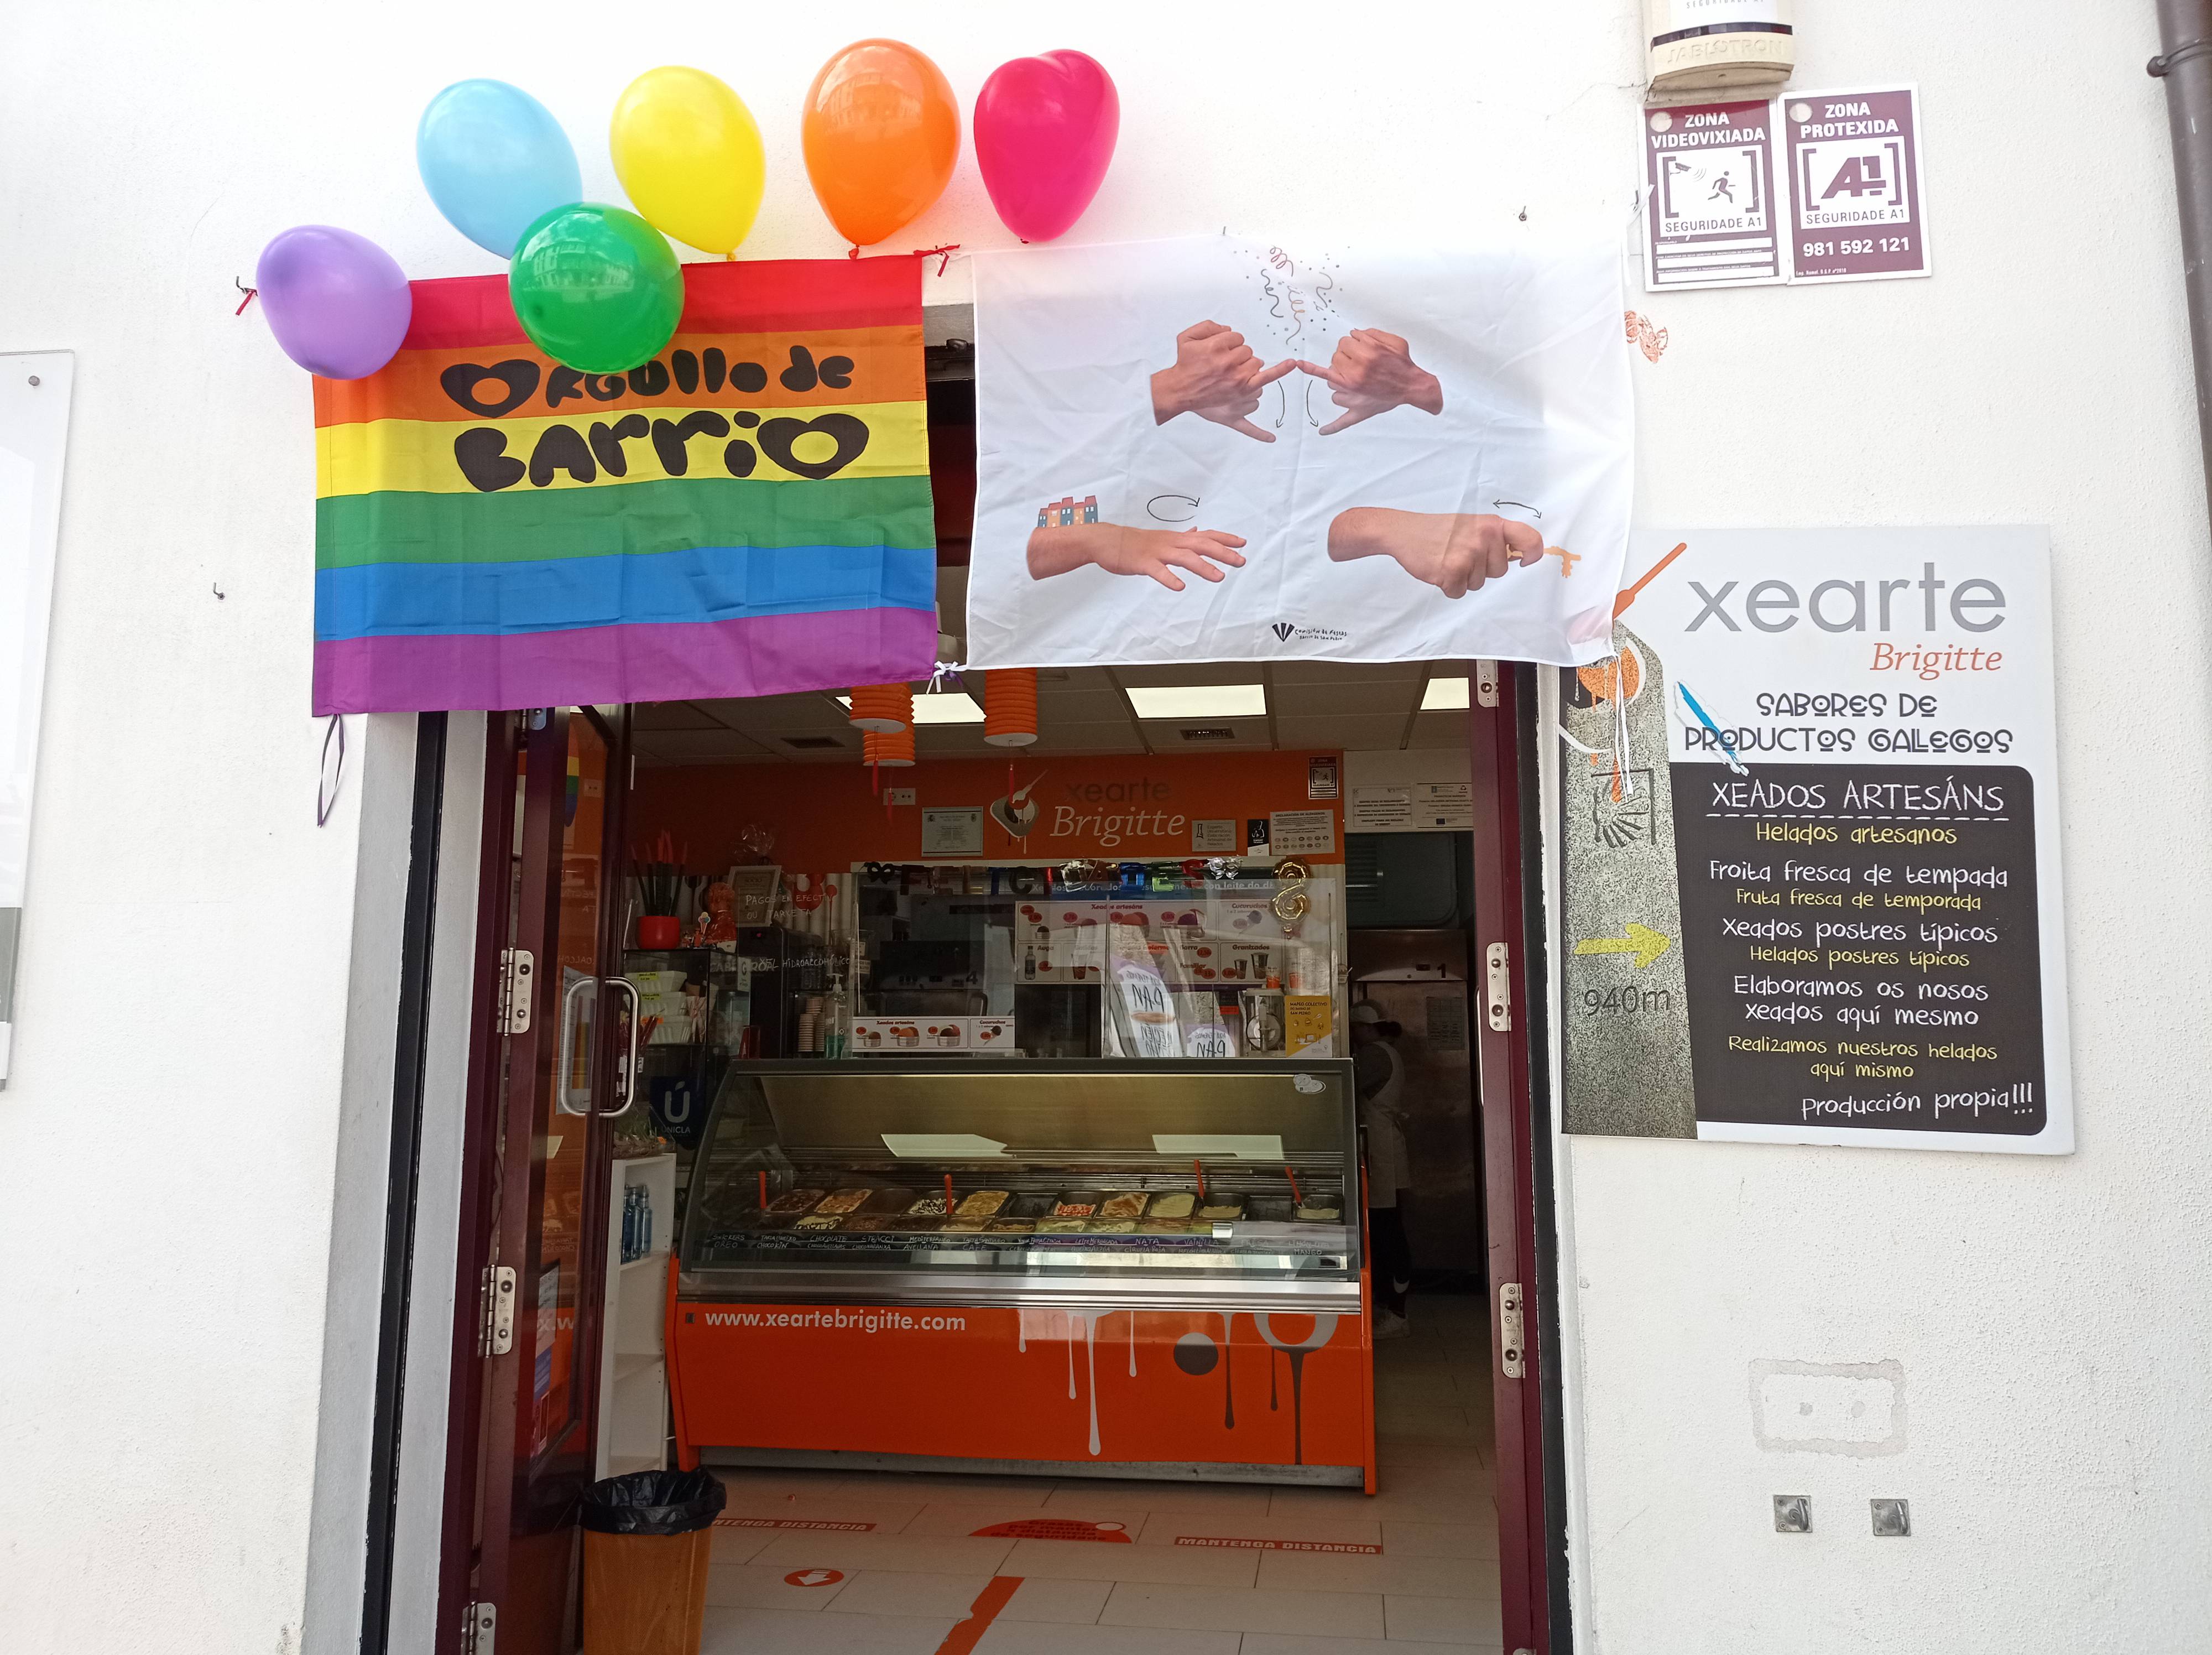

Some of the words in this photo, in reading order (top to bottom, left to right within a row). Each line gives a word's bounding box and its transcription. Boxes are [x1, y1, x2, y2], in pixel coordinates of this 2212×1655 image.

[1668, 39, 1782, 64] JABLOTRON
[1685, 112, 1730, 128] ZONA
[1825, 102, 1871, 118] ZONA
[1651, 127, 1766, 149] VIDEOVIXIADA
[1801, 118, 1899, 138] PROTEXIDA
[1666, 218, 1743, 232] SEGURIDADE
[1747, 217, 1761, 227] A1
[1806, 210, 1885, 224] SEGURIDADE
[1890, 209, 1904, 219] A1
[1803, 242, 1834, 257] 981
[1840, 239, 1874, 254] 592
[1879, 237, 1910, 252] 121
[1684, 561, 2006, 633] xearte
[1870, 643, 2003, 681] Brigitte
[1756, 693, 1887, 718] SABORES
[1900, 694, 1937, 717] DE
[1684, 727, 1856, 753] PRODUCTOS
[1868, 728, 2013, 754] GALLEGOS
[1065, 777, 1171, 804] xearte
[1713, 783, 1827, 809] XEADOS
[1844, 778, 2004, 812] ARTESÁNS
[1050, 805, 1185, 847] Brigitte
[1756, 823, 1838, 842] Helados
[1851, 826, 1958, 845] artesanos
[1710, 860, 1771, 882] Froita
[1784, 861, 1851, 884] fresca
[1864, 864, 1892, 886] de
[1906, 866, 2008, 894] tempada
[747, 894, 776, 905] PAGOS
[1736, 889, 1780, 905] Fruta
[1790, 889, 1842, 908] fresca
[1852, 891, 1874, 908] de
[1885, 893, 1981, 914] temporada
[1723, 918, 1802, 939] Xeados
[1817, 920, 1907, 948] postres
[1920, 920, 1999, 951] típicos
[1750, 946, 1818, 964] Helados
[1829, 948, 1900, 970] postres
[1910, 948, 1970, 972] típicos
[1583, 987, 1671, 1016] 940m
[1734, 976, 1863, 999] Elaboramos
[1877, 982, 1905, 1000] os
[1919, 982, 1989, 1002] nosos
[1746, 1003, 1823, 1023] xeados
[1837, 1004, 1880, 1032] aquí
[1895, 1008, 1979, 1027] mesmo
[1729, 1036, 1827, 1054] Realizamos
[1838, 1040, 1919, 1057] nuestros
[1928, 1043, 1998, 1060] helados
[1810, 1063, 1844, 1082] aquí
[1856, 1064, 1914, 1080] mismo
[1802, 1091, 1921, 1120] Producción
[1935, 1082, 2034, 1120] propia!!!
[705, 1309, 966, 1333] www.xeartebrigitte.com
[779, 1522, 868, 1531] DISTANCIA
[1178, 1538, 1276, 1549] MANTENGA
[1282, 1543, 1377, 1554] DISTANCIA
